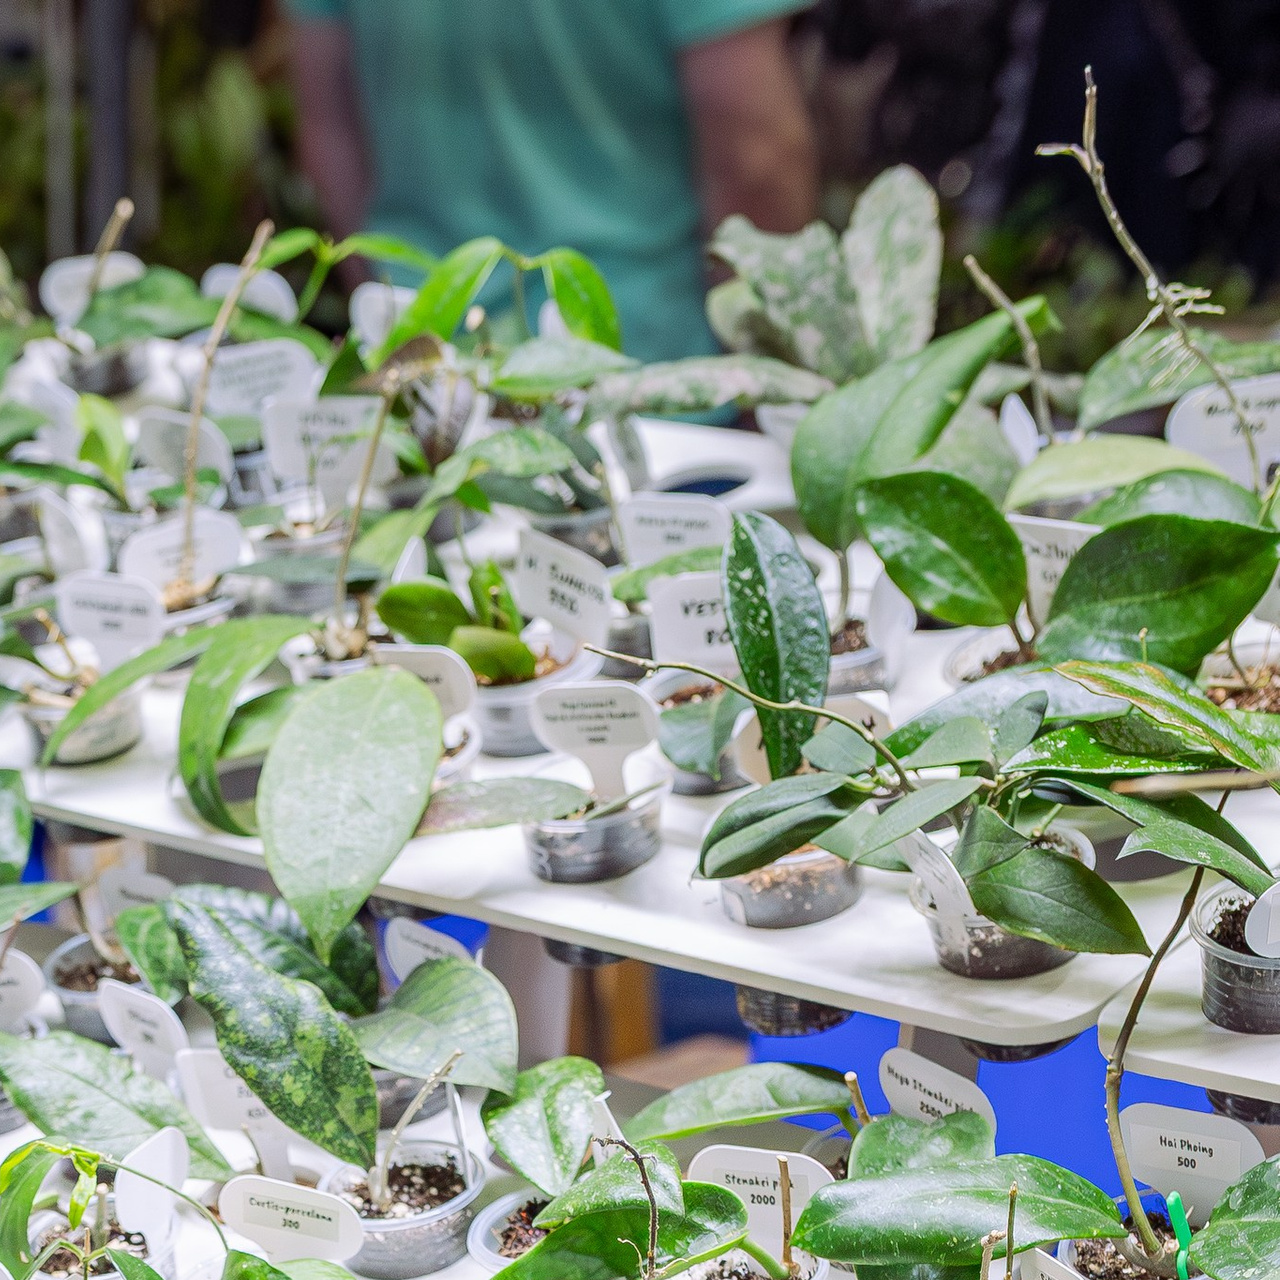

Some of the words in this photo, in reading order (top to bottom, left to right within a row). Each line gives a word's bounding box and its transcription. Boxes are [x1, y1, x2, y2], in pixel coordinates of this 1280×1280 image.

[1159, 1135, 1177, 1149] Hai
[1180, 1139, 1214, 1158] Phoing
[1177, 1156, 1196, 1169] 500
[750, 1193, 776, 1205] 2000
